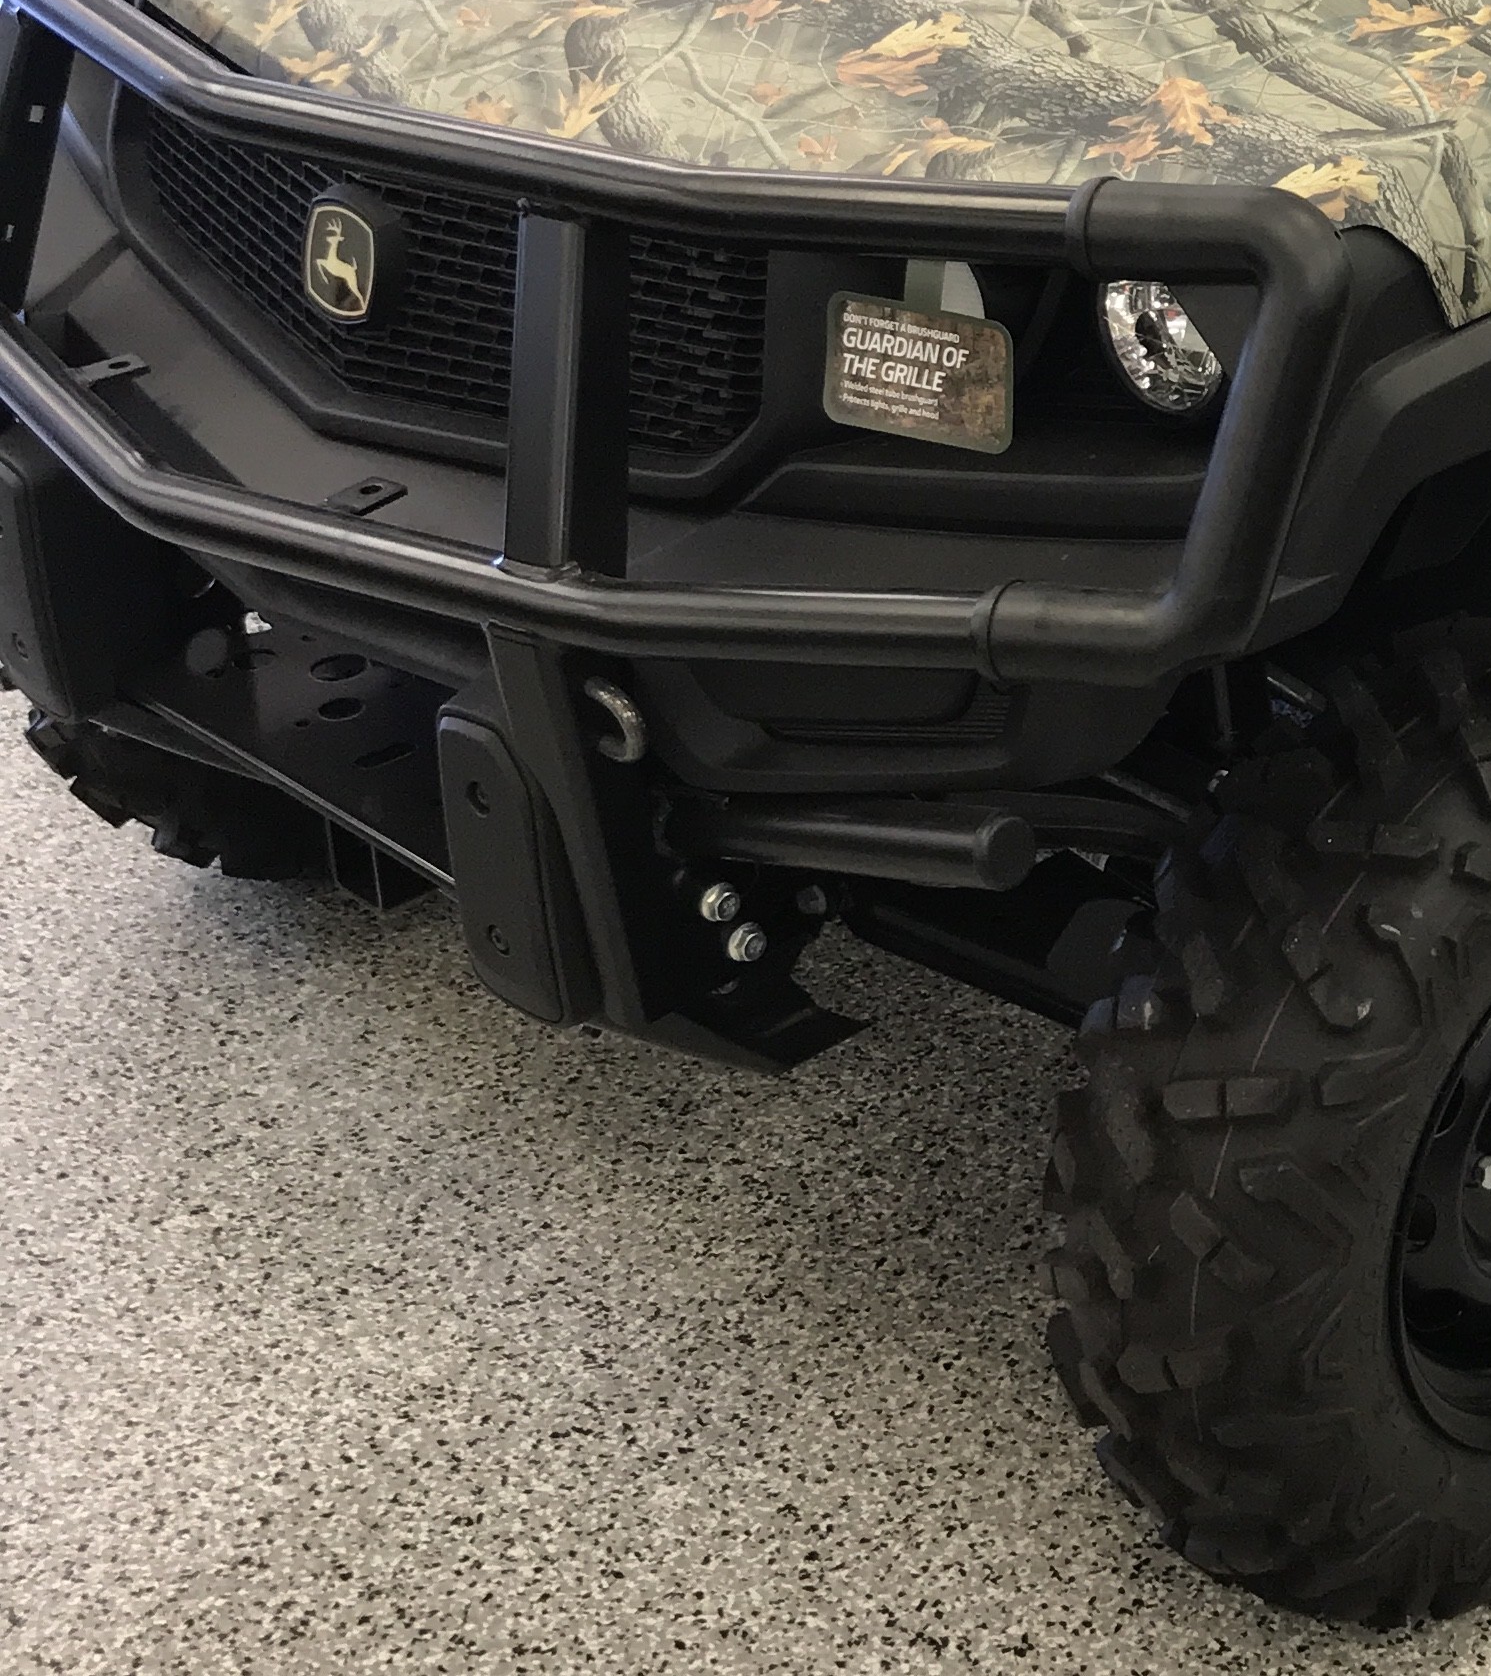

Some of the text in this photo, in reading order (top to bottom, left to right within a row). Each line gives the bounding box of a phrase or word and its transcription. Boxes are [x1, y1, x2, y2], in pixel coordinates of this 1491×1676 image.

[842, 327, 969, 368] GUARDIAN OF
[843, 314, 867, 324] DON'T
[869, 317, 899, 331] FORGET
[907, 324, 960, 343] BRUSHGUARD
[843, 353, 946, 392] THE GRILLE
